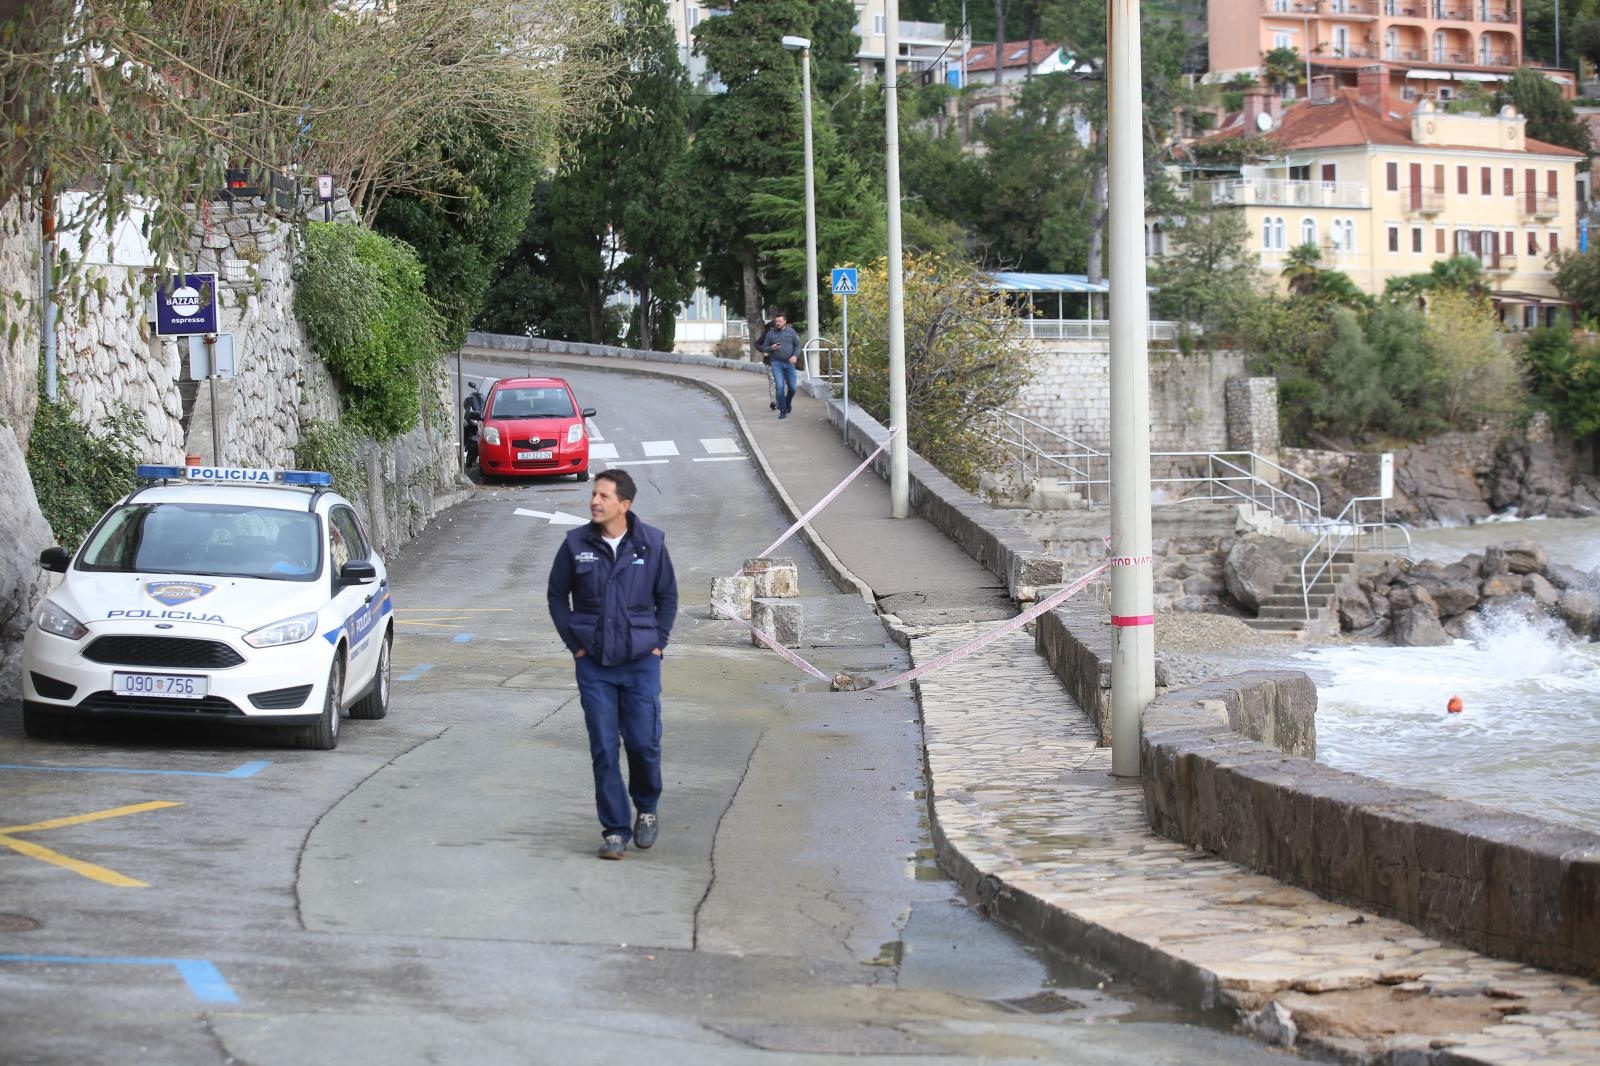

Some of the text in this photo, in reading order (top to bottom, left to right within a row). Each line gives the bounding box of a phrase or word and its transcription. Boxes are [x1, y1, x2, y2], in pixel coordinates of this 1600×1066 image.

[166, 297, 205, 306] BAZZAR
[191, 468, 270, 481] POLICIJA
[107, 609, 225, 624] POLICIJA
[126, 675, 194, 694] 090 756
